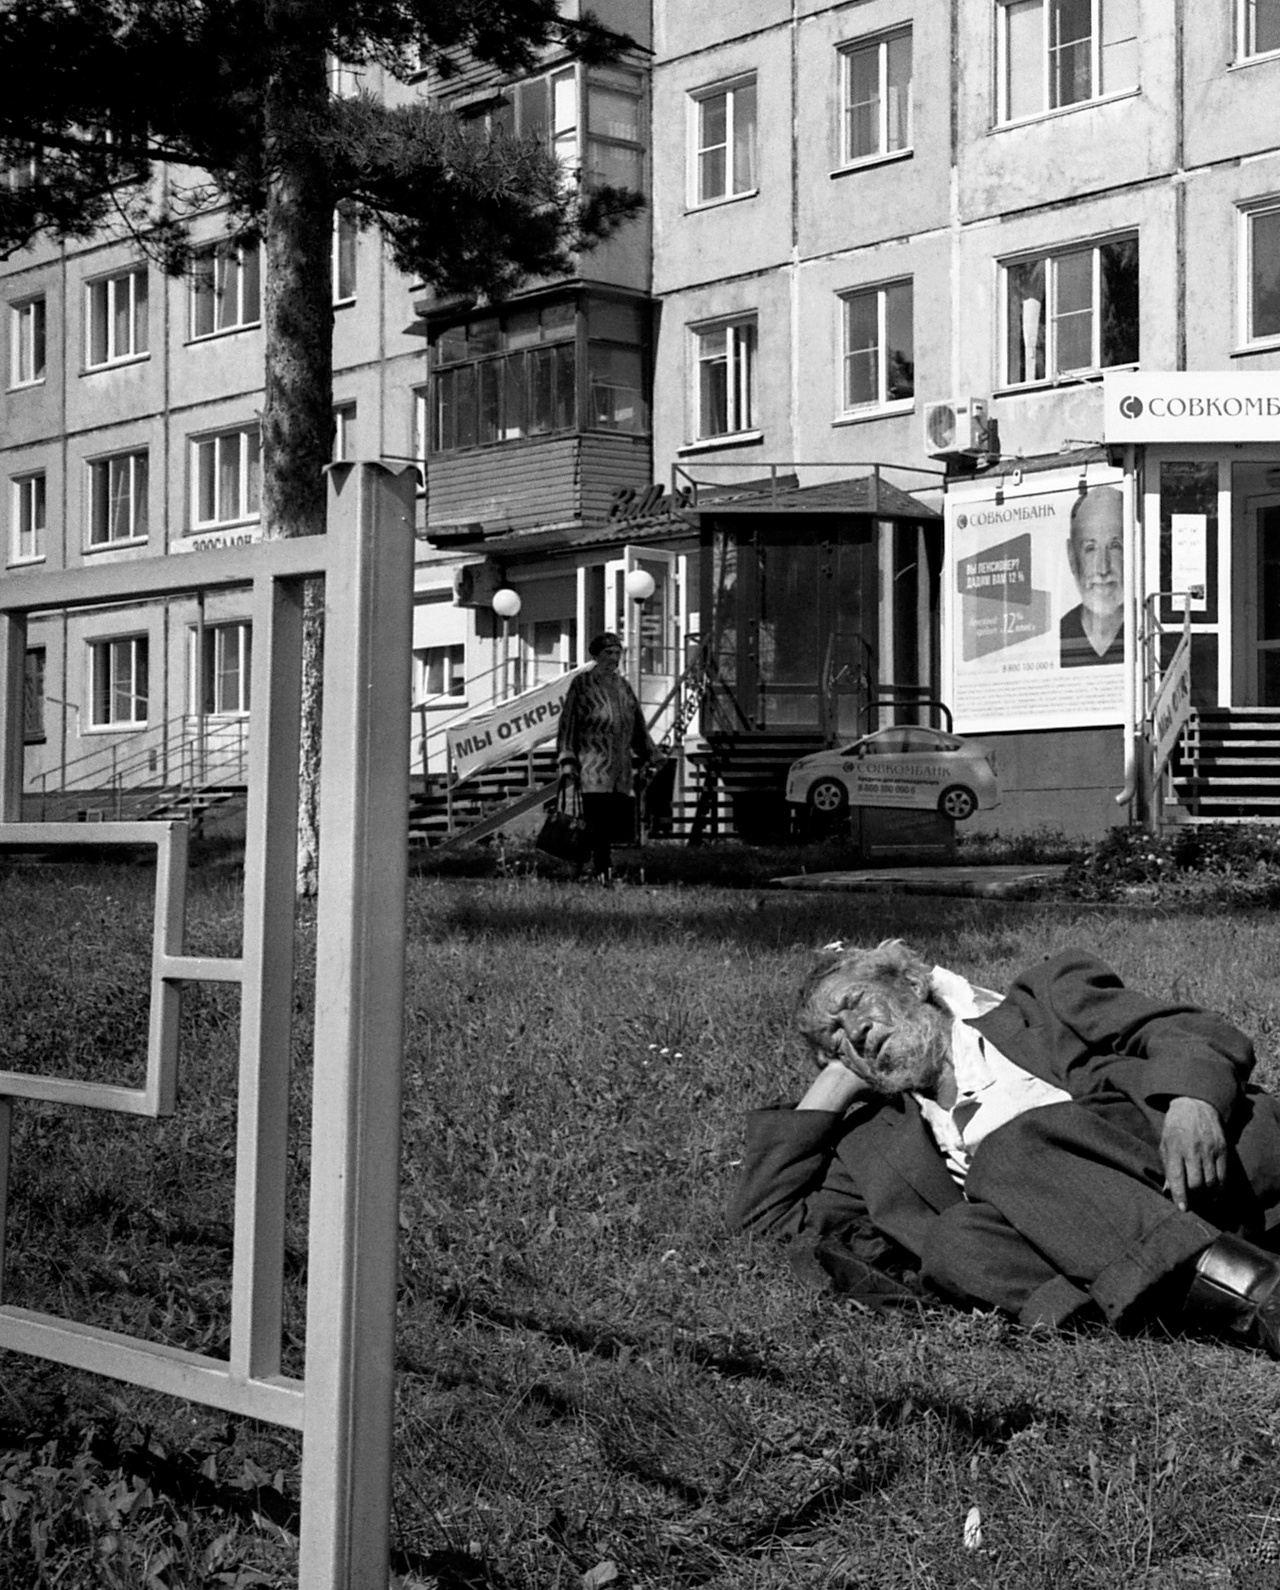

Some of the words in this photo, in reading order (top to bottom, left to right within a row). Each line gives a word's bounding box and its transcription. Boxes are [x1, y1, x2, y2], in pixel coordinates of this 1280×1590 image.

[969, 503, 1056, 527] СОВКОМБАНК
[455, 731, 493, 759] МЫ
[857, 762, 951, 777] СОВКОМБАНК
